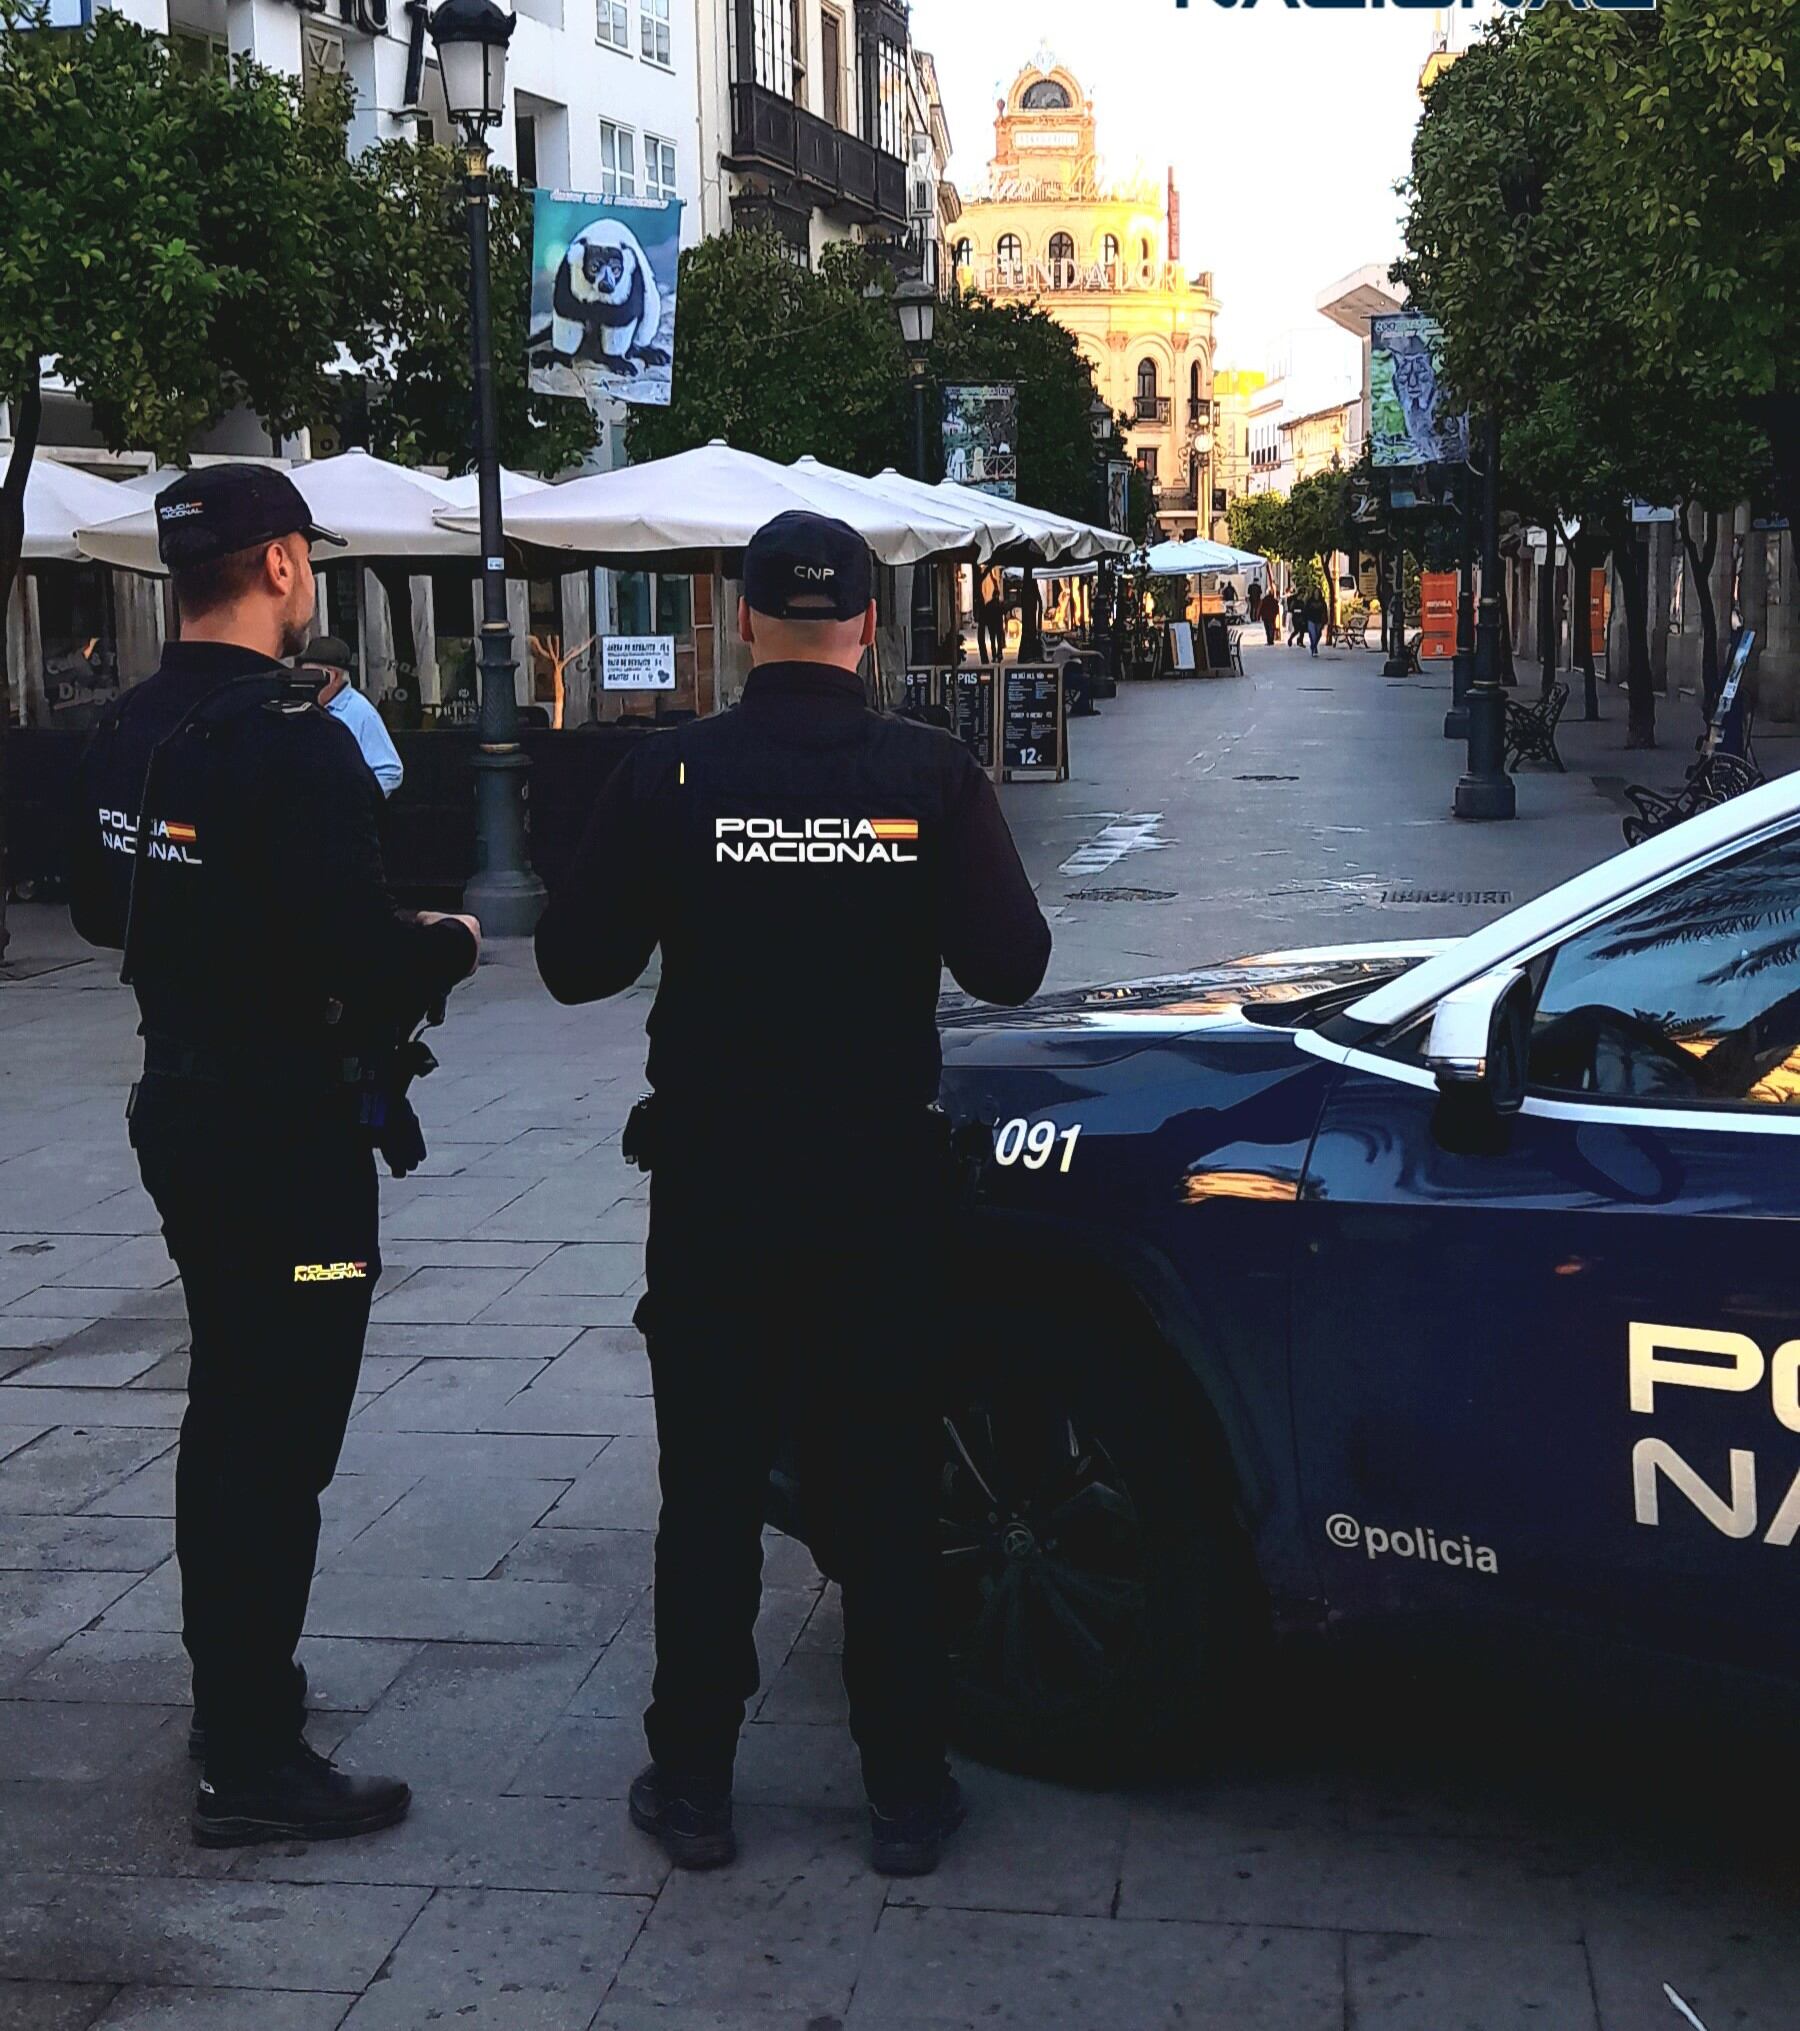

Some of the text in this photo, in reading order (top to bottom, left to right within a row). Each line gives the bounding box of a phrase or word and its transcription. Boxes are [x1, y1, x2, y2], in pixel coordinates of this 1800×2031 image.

[793, 565, 835, 581] CNP
[945, 673, 978, 685] TPAS
[102, 830, 203, 865] NACNAL
[716, 842, 918, 863] NACIONAL
[995, 1118, 1082, 1173] 091
[294, 1270, 367, 1282] NACIONAL
[1325, 1513, 1499, 1574] @policia
